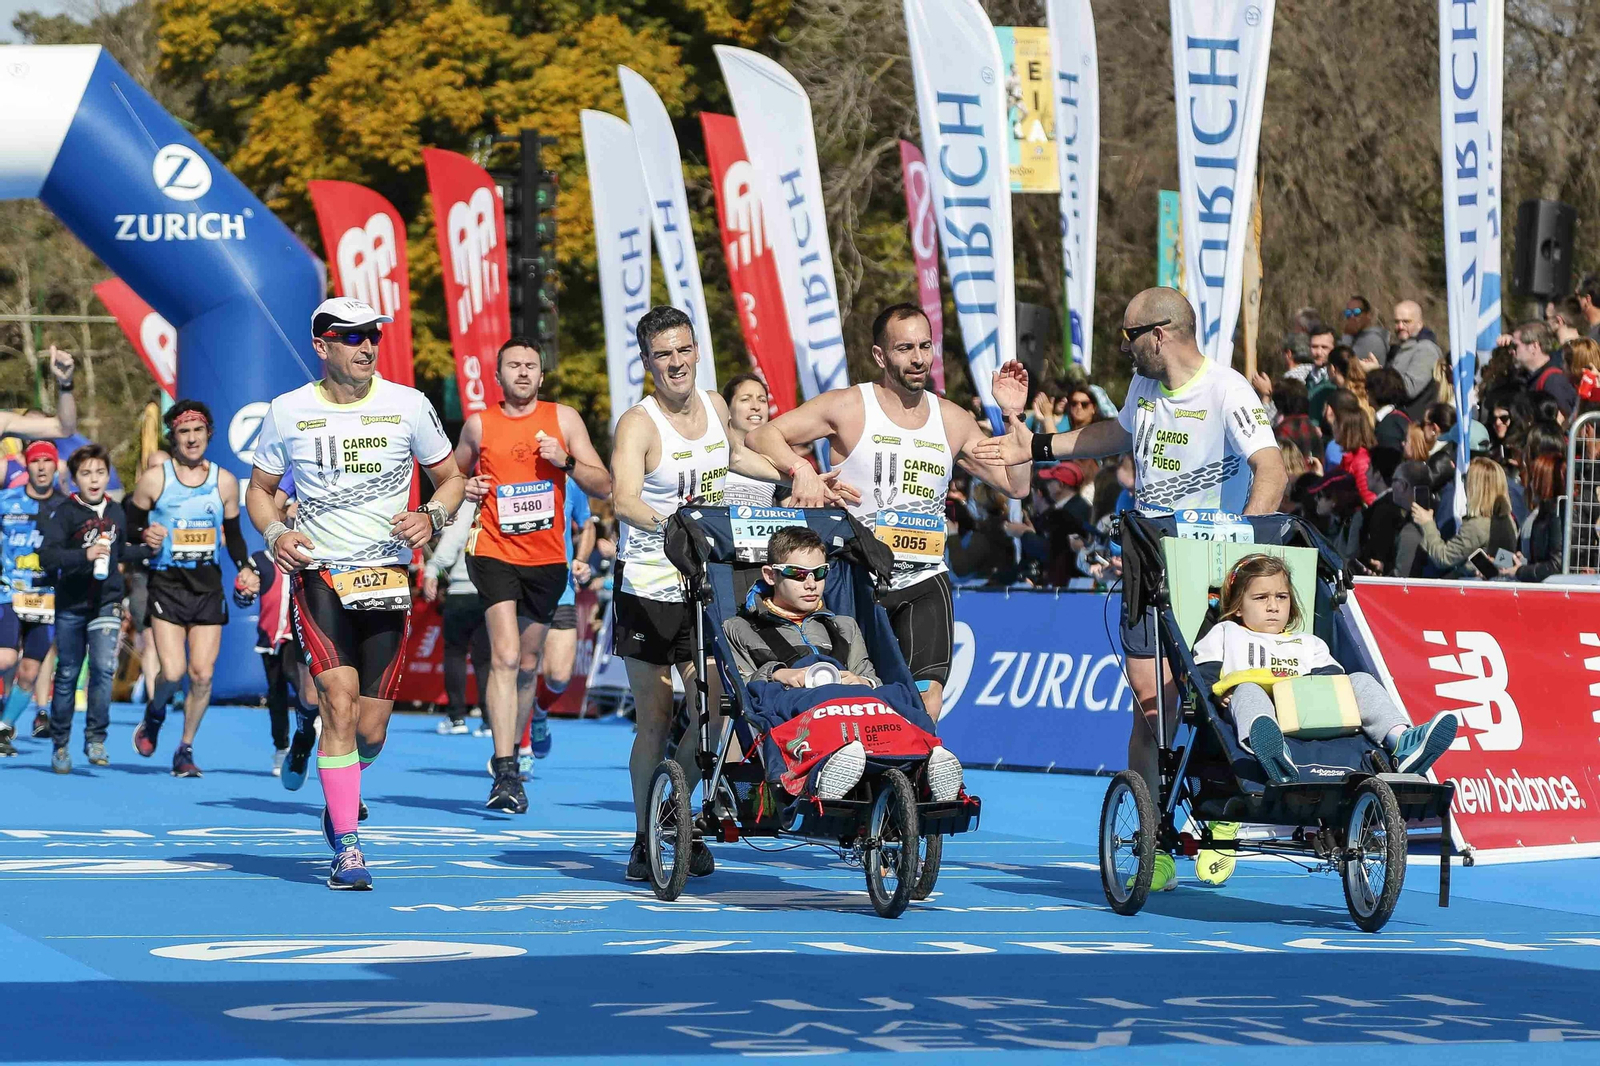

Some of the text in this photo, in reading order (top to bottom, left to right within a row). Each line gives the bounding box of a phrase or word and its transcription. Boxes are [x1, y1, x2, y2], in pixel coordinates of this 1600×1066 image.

[114, 212, 246, 241] ZURICH
[343, 437, 388, 450] CARROS
[1156, 429, 1189, 445] CARROS
[1152, 443, 1165, 456] DE
[344, 451, 359, 462] DE
[344, 462, 382, 474] FUEGO
[904, 459, 945, 477] CARROS
[1151, 456, 1181, 472] FUEGO
[902, 471, 918, 483] DE
[515, 483, 548, 494] ZURICH
[700, 482, 712, 493] DE
[902, 483, 935, 500] FUEGO
[513, 499, 542, 513] 5480
[755, 509, 796, 519] ZURICH
[1200, 511, 1243, 522] ZURICH
[900, 516, 938, 528] ZURICH
[892, 534, 927, 551] 3055
[864, 724, 902, 734] CARROS
[866, 734, 879, 742] DE
[1447, 768, 1582, 814] new balance
[592, 994, 1486, 1016] ZURICH
